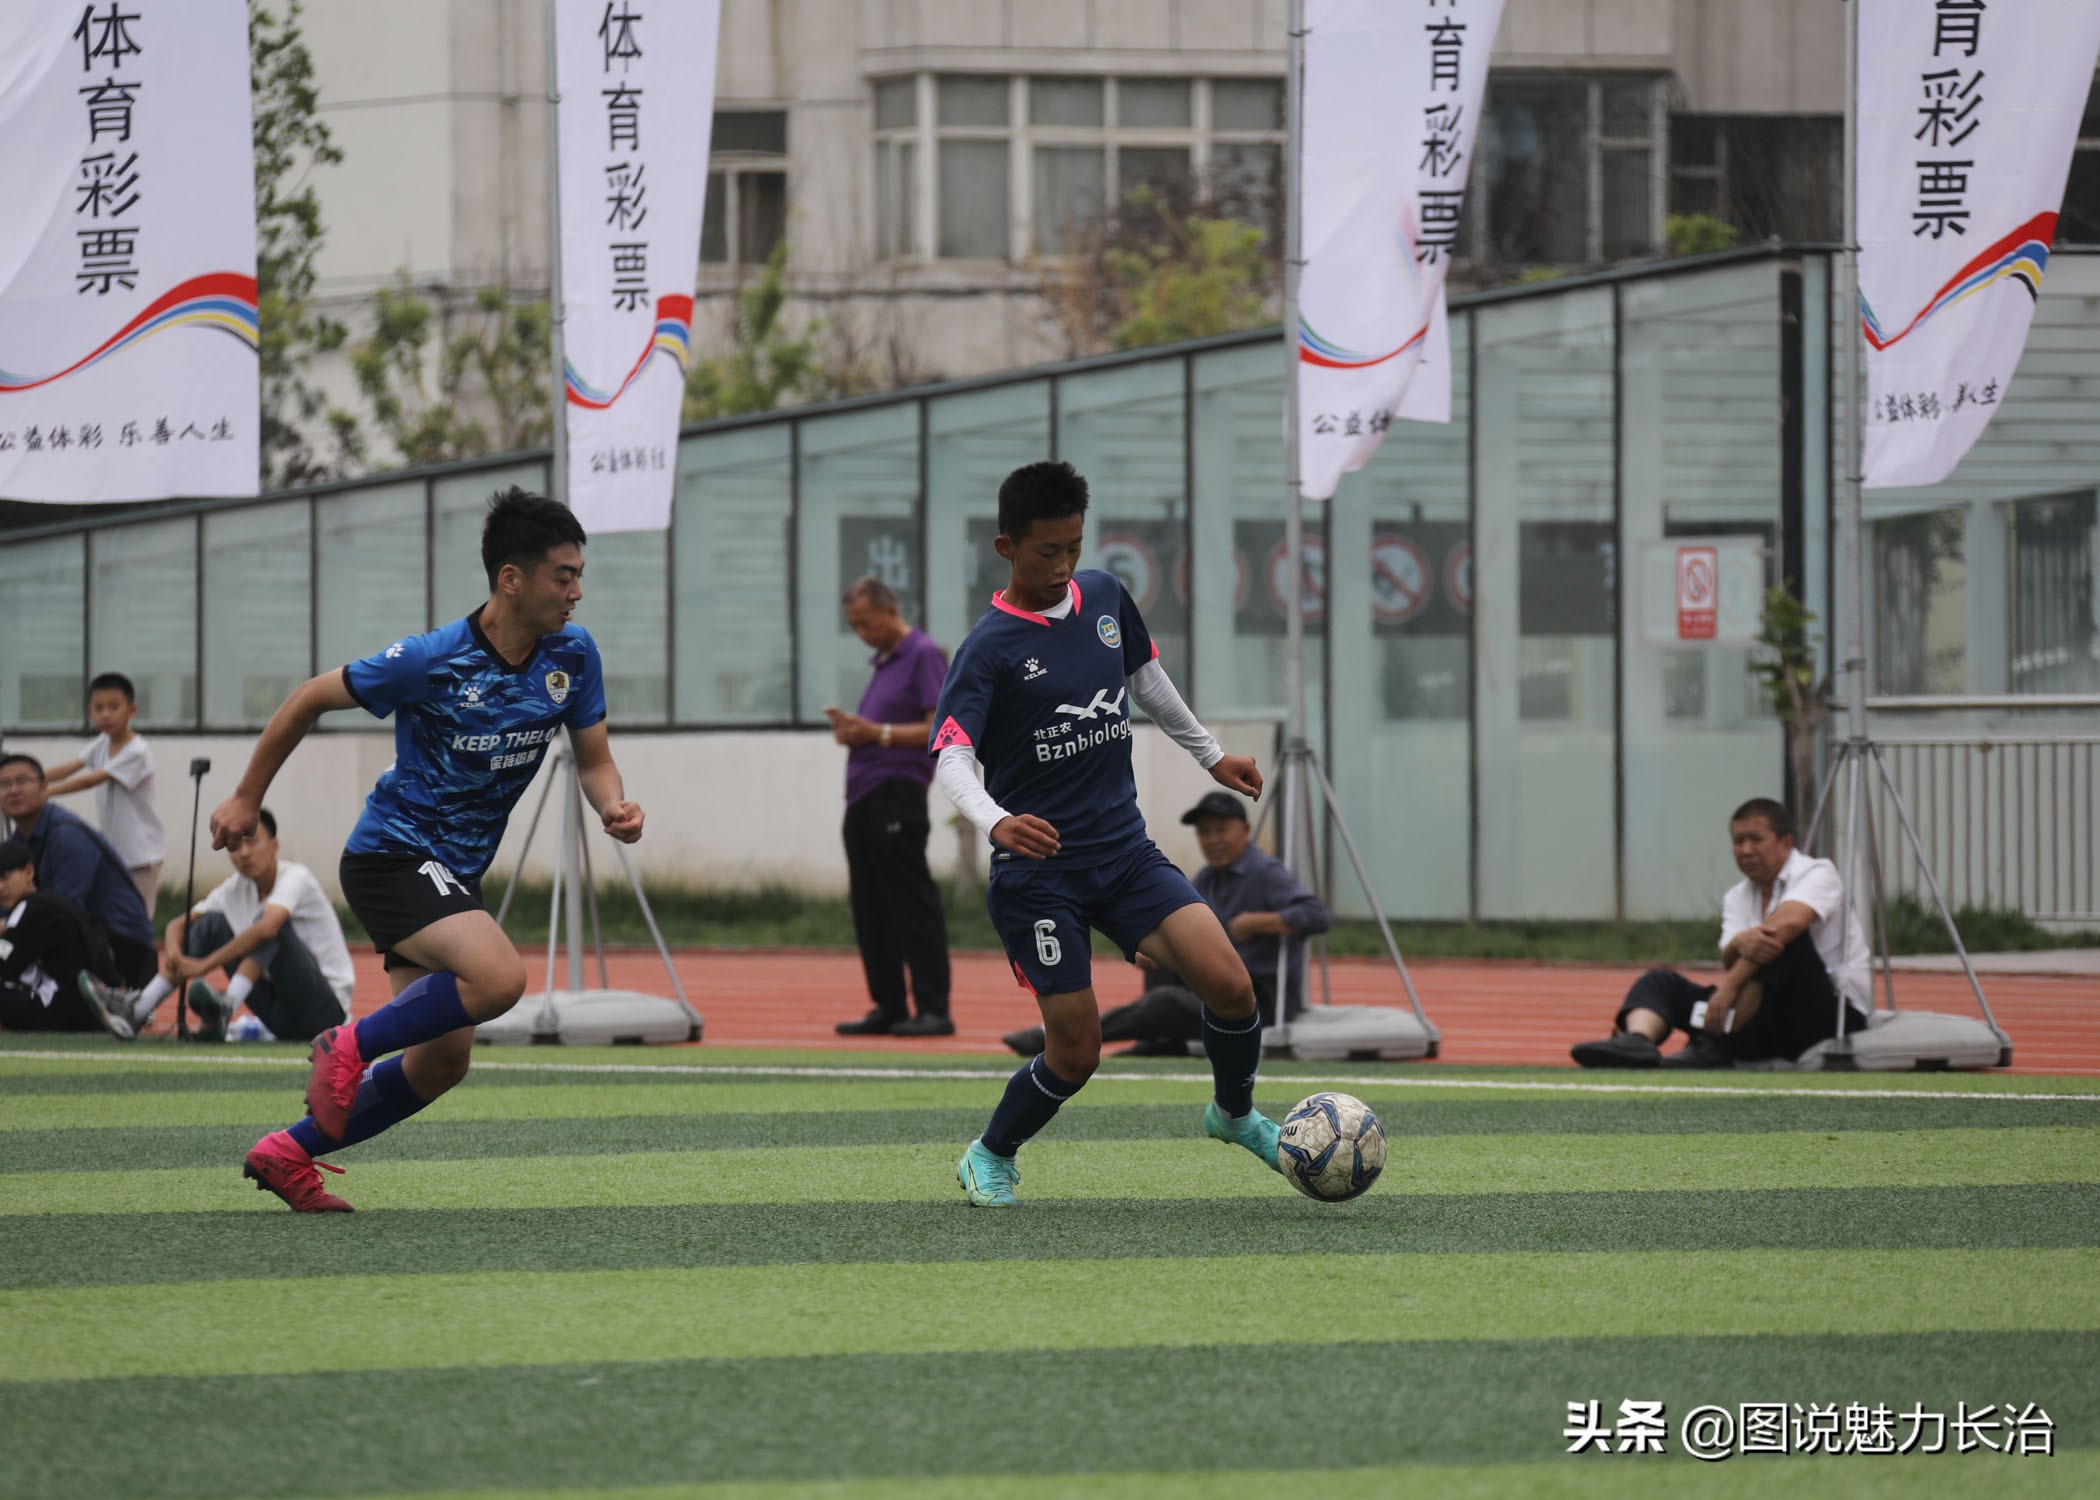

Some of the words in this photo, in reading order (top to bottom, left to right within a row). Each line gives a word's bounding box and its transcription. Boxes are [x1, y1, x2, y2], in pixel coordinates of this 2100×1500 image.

[1415, 0, 1466, 264] 育彩票
[1912, 0, 1987, 240] 育彩票
[73, 2, 143, 296] 体育彩票
[598, 0, 650, 312] 体育彩票
[0, 421, 103, 452] 公益体彩
[119, 415, 235, 447] 乐善人生
[1024, 668, 1049, 681] KELME
[452, 734, 501, 752] KEEP
[505, 725, 559, 749] THELO
[1033, 721, 1073, 742] 北正农
[1036, 716, 1132, 763] Bznbiology
[1033, 918, 1062, 967] 6
